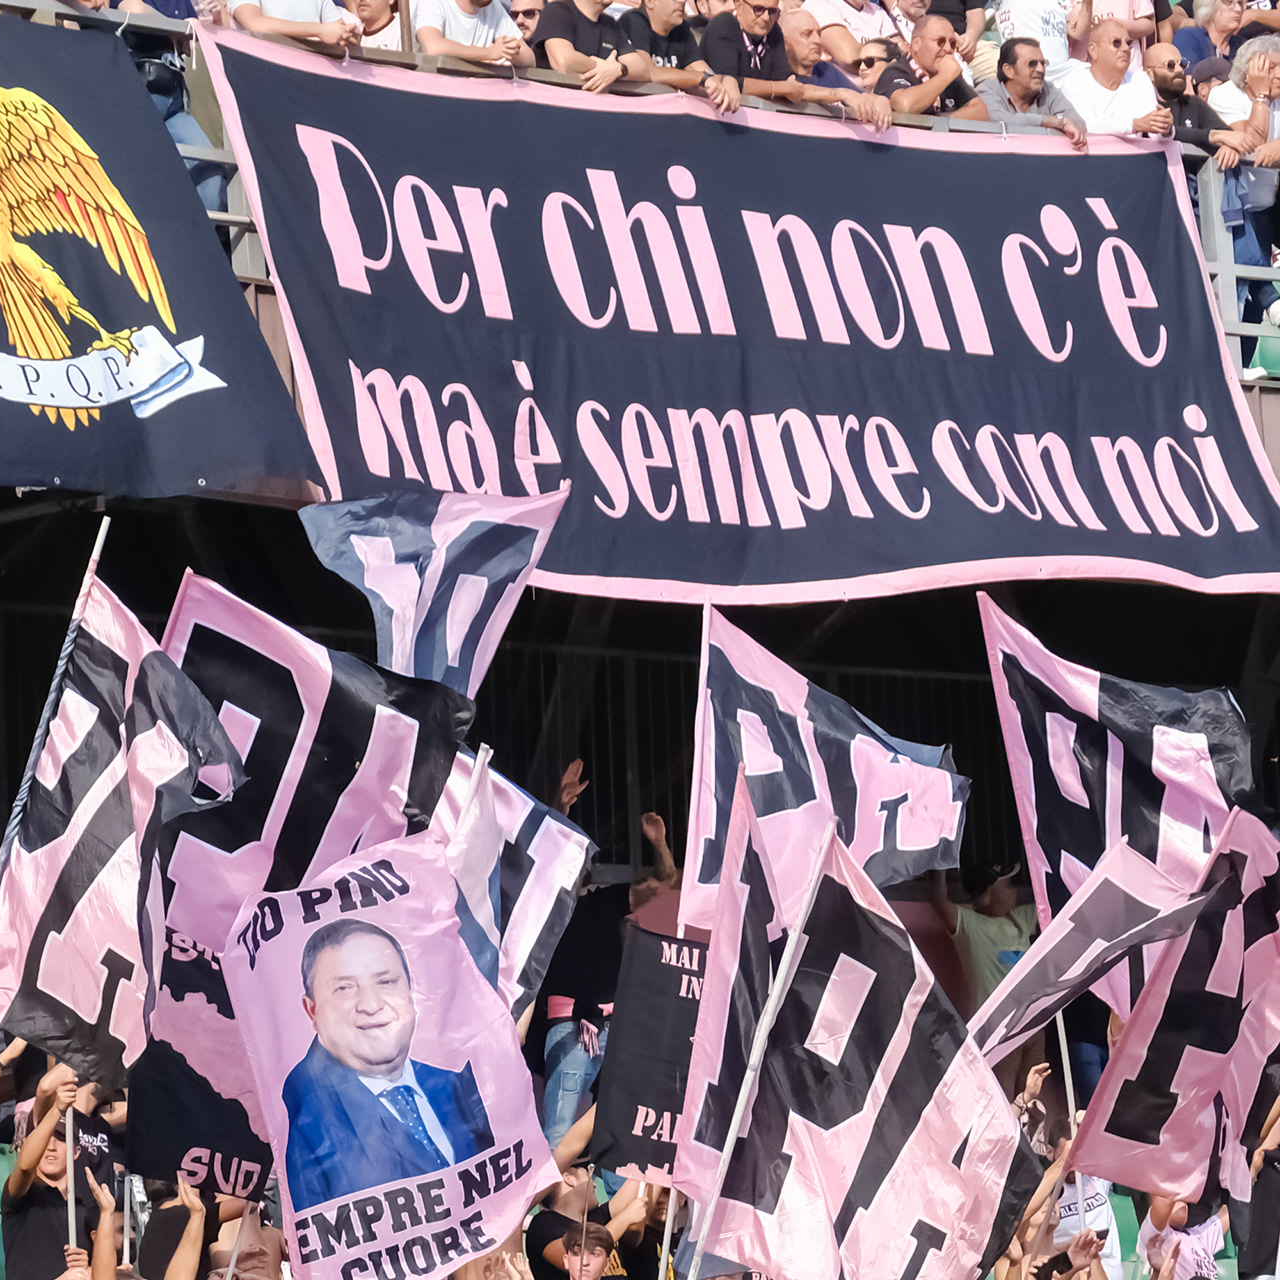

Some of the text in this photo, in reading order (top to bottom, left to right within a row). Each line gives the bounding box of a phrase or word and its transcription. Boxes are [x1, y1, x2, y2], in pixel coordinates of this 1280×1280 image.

[295, 122, 514, 321] Per
[540, 165, 737, 337] chi
[740, 207, 995, 356] non
[349, 357, 1260, 537] ma è sempre con noi
[301, 858, 411, 925] PINO
[659, 940, 699, 972] MAI
[294, 1138, 533, 1266] EMPRE NEL
